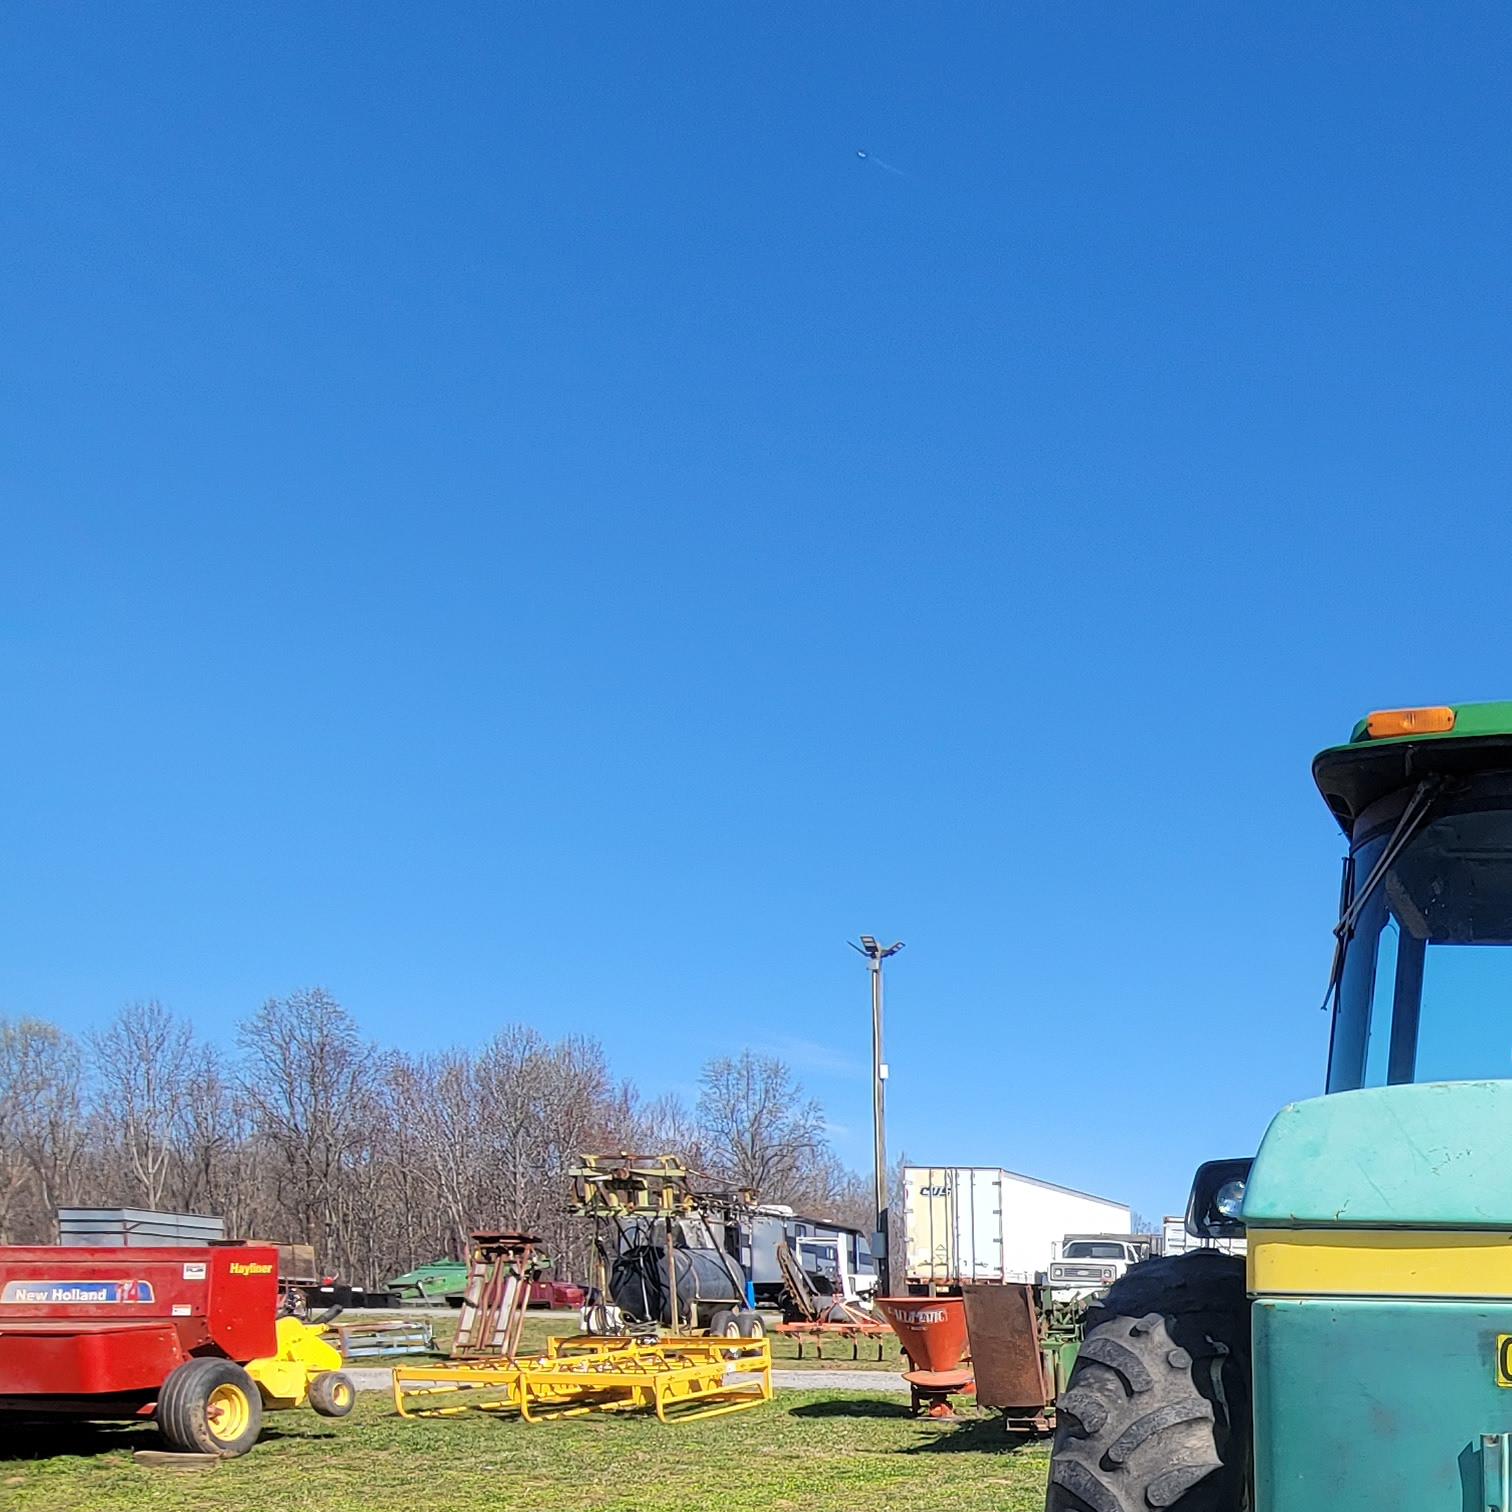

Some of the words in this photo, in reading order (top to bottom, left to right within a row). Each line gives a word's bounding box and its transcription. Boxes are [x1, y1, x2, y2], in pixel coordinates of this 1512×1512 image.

[229, 1262, 273, 1276] Hayliner
[15, 1289, 48, 1301] New
[52, 1288, 107, 1301] Holland
